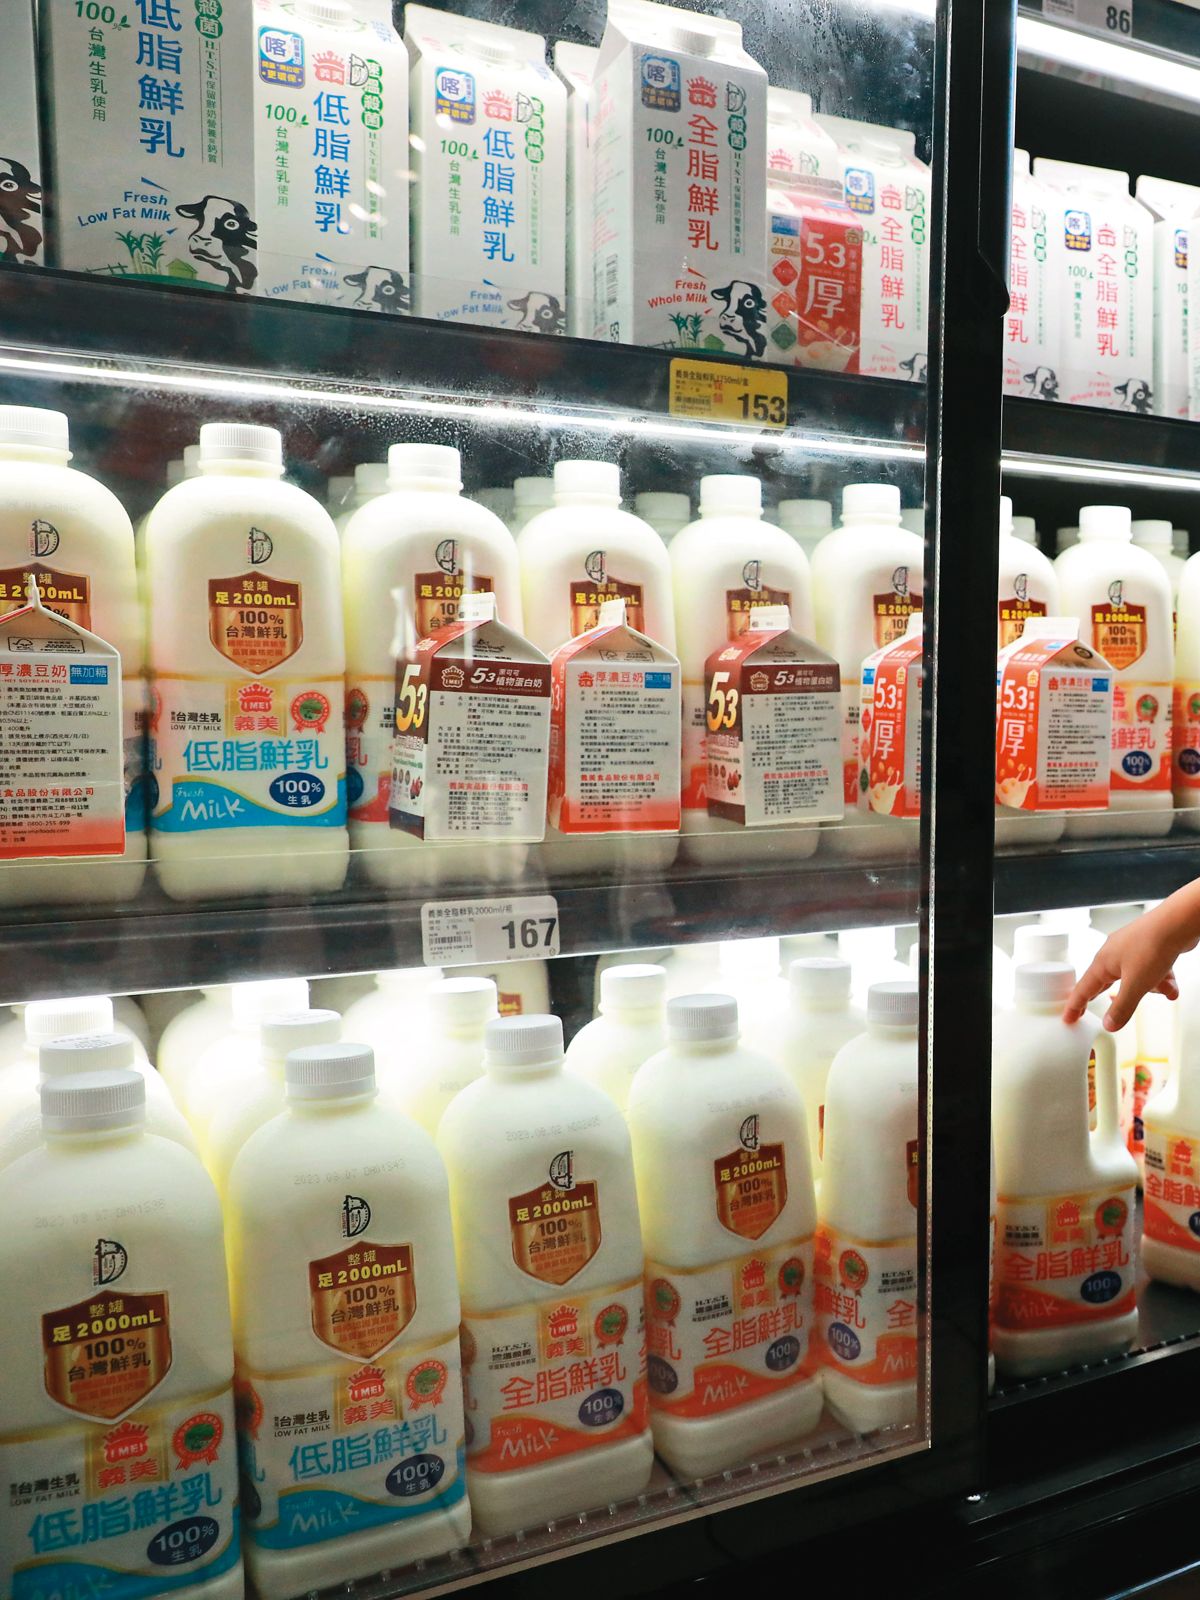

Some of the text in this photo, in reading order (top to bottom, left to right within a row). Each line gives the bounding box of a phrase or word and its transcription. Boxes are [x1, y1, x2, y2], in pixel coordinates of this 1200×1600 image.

[1106, 8, 1131, 33] 86
[88, 26, 108, 122] 台灣生乳使用
[134, 0, 185, 158] 低脂鮮乳
[275, 126, 290, 207] 台灣生乳使用
[313, 91, 351, 235] 低脂鮮乳
[482, 127, 515, 262] 低脂鮮乳
[654, 148, 668, 225] 台灣生乳使用
[686, 113, 720, 251] 全脂鮮乳
[124, 191, 168, 206] Fresh
[77, 208, 171, 229] Low Fat Milk
[805, 232, 846, 269] 5.3
[675, 280, 706, 291] Fresh
[879, 216, 906, 330] 全脂鮮乳
[264, 283, 289, 297] Low
[293, 279, 311, 289] Fat
[470, 290, 502, 301] Fresh
[804, 275, 846, 319] 厚
[462, 304, 479, 314] Fat
[482, 303, 504, 315] Milk
[648, 293, 708, 309] Whole Milk
[1097, 253, 1119, 357] 全脂鮮乳
[736, 393, 785, 423] 153
[242, 580, 269, 592] 整罐
[238, 610, 284, 625] 100%
[226, 625, 288, 639] 台灣鮮乳
[71, 667, 107, 678] 無加糖
[496, 677, 543, 689] 植物蛋白奶
[595, 671, 644, 684] 厚濃豆奶
[875, 677, 897, 709] 5.3
[1003, 679, 1028, 710] 5.3
[176, 711, 222, 723] 台灣生乳
[234, 716, 280, 732] 義美
[872, 720, 895, 760] 厚
[1000, 719, 1026, 757] 厚
[182, 739, 329, 772] 低脂鮮乳
[274, 779, 321, 793] 100%
[287, 795, 312, 805] 生乳
[502, 917, 557, 949] 167
[533, 1195, 593, 1218] 2000mL
[347, 1250, 377, 1266] 整罐
[1002, 1239, 1130, 1281] 全脂鮮乳
[318, 1259, 407, 1288] 足 2000mL
[344, 1284, 395, 1304] 100%
[90, 1299, 125, 1318] 整罐
[331, 1297, 400, 1325] 台灣鮮乳
[53, 1310, 161, 1342] 足 2000mL
[702, 1302, 804, 1360] 全脂鮮乳
[84, 1337, 147, 1360] 100%
[545, 1336, 585, 1359] 義美
[68, 1351, 151, 1382] 台灣鮮乳
[500, 1351, 627, 1410] 全脂鮮乳
[279, 1409, 331, 1428] 台灣生乳
[343, 1399, 395, 1426] 義美
[274, 1423, 331, 1438] LOW FAT MILK
[288, 1413, 447, 1481] 低脂鮮乳
[18, 1472, 81, 1495] 台灣生乳
[98, 1458, 158, 1489] 義美
[391, 1461, 441, 1485] 100%
[35, 1493, 53, 1503] FAT
[55, 1488, 81, 1500] MILK
[405, 1479, 431, 1493] 生乳
[28, 1472, 223, 1555] 低脂鮮乳
[155, 1523, 216, 1552] 100%
[171, 1544, 202, 1563] 生乳
